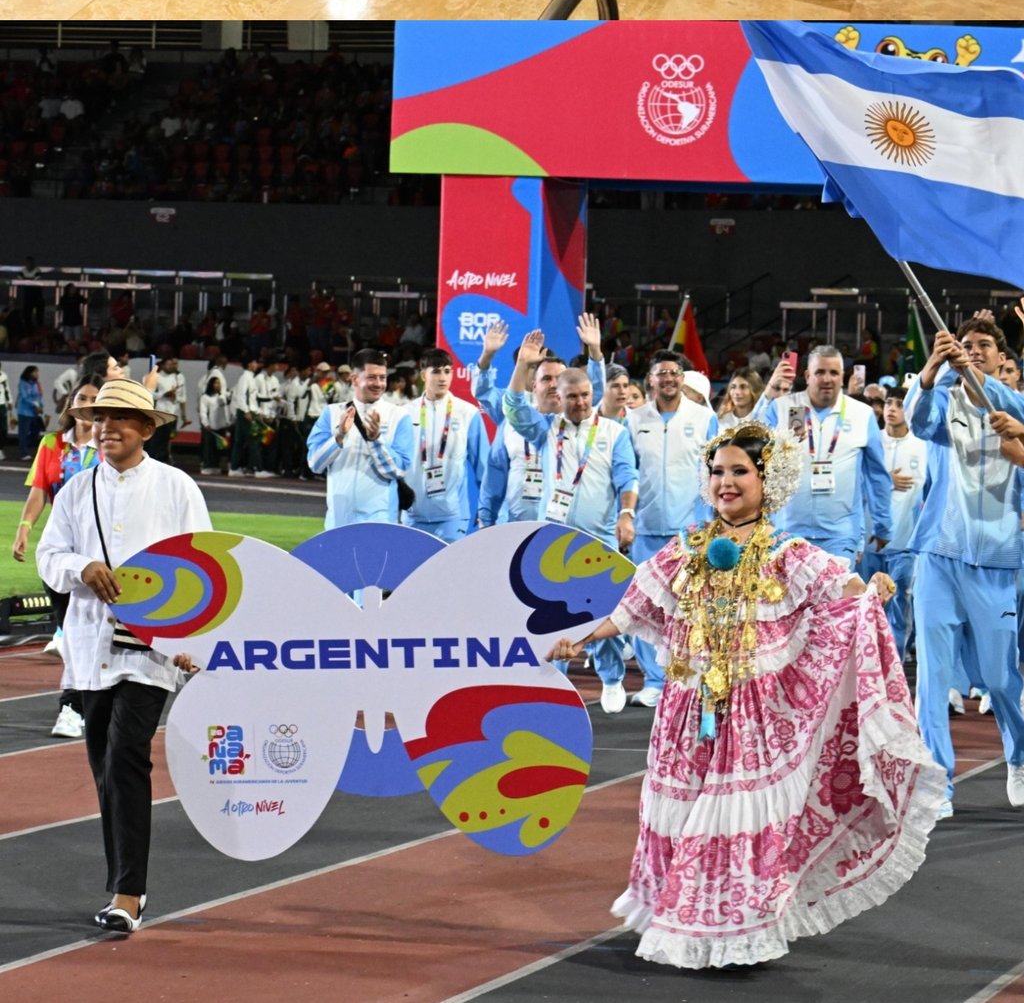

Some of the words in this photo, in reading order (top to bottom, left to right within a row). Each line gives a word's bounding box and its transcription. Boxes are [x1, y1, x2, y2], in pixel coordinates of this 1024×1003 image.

[484, 272, 518, 289] NIVEL
[207, 636, 539, 671] ARGENTINA
[220, 799, 230, 816] A
[255, 799, 285, 815] NIVEL
